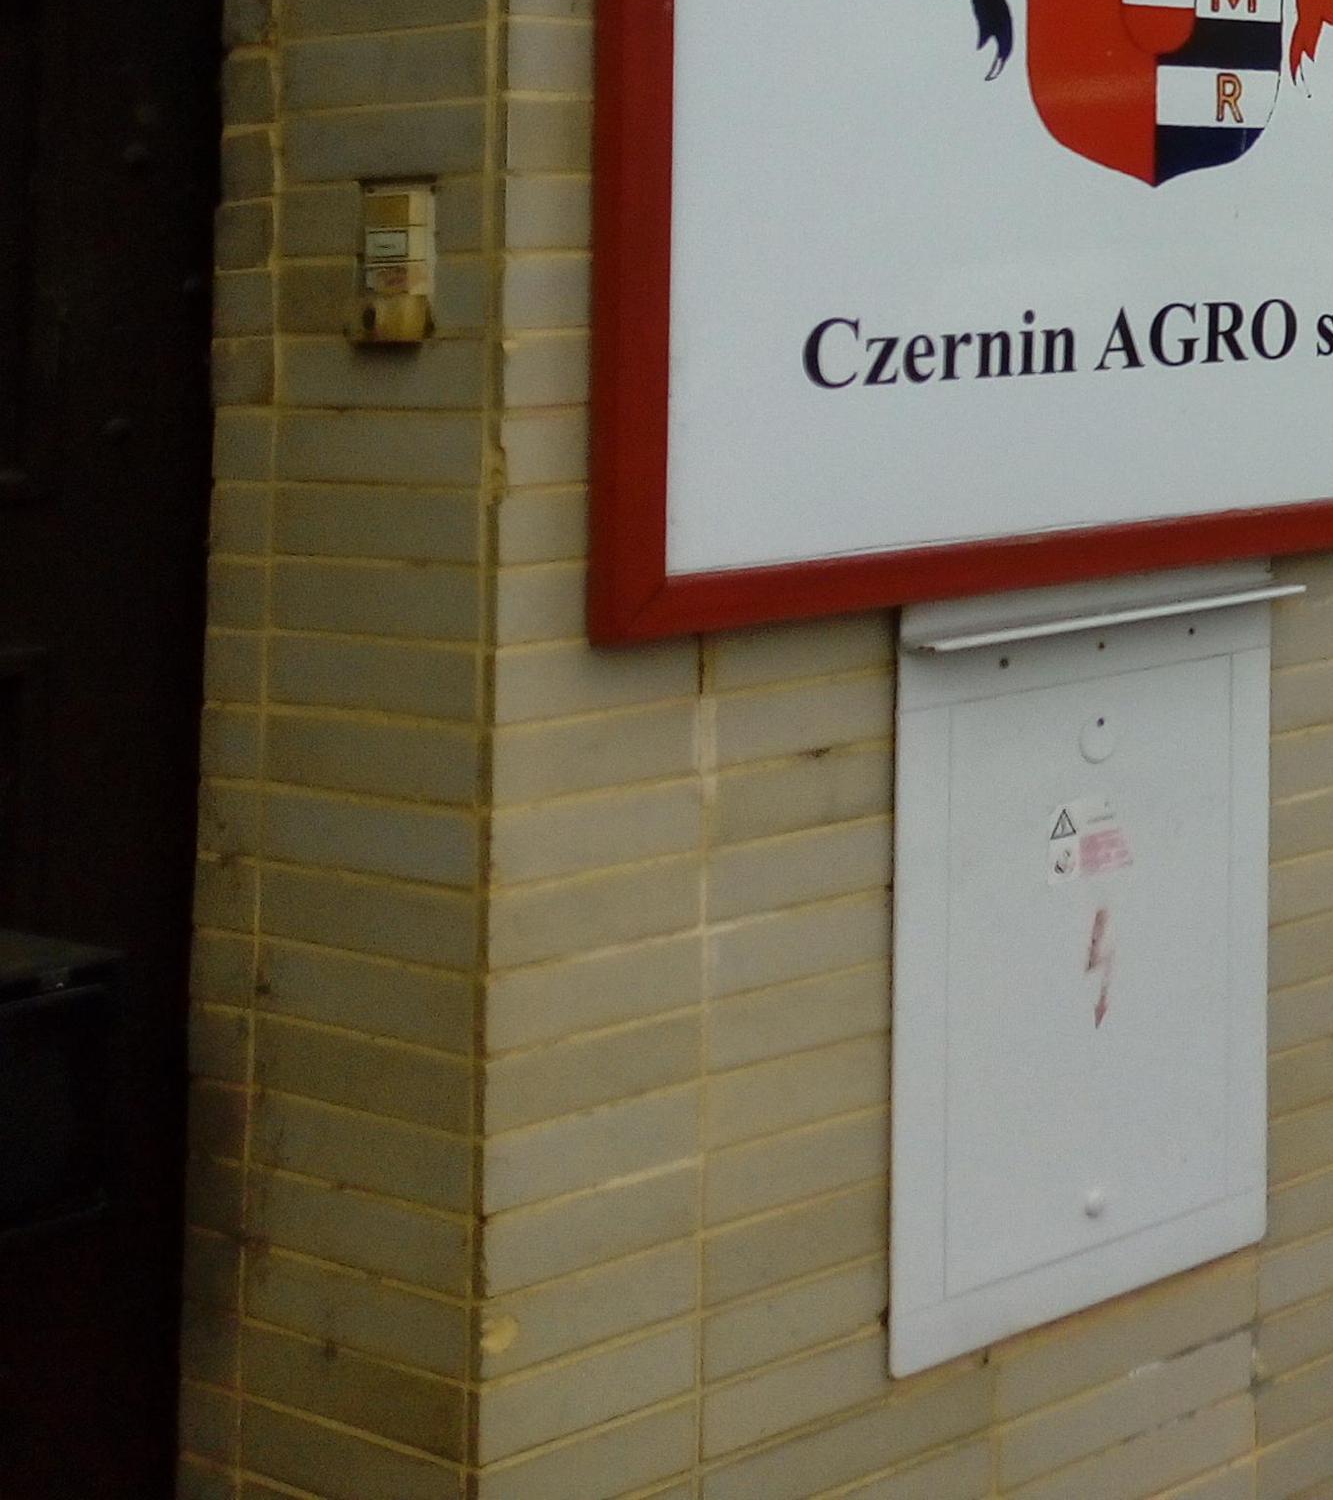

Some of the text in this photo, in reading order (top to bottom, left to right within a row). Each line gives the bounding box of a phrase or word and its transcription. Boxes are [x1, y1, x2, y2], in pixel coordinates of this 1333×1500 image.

[1215, 72, 1243, 124] R
[802, 310, 1076, 391] Czernin
[1093, 298, 1298, 371] AGRO
